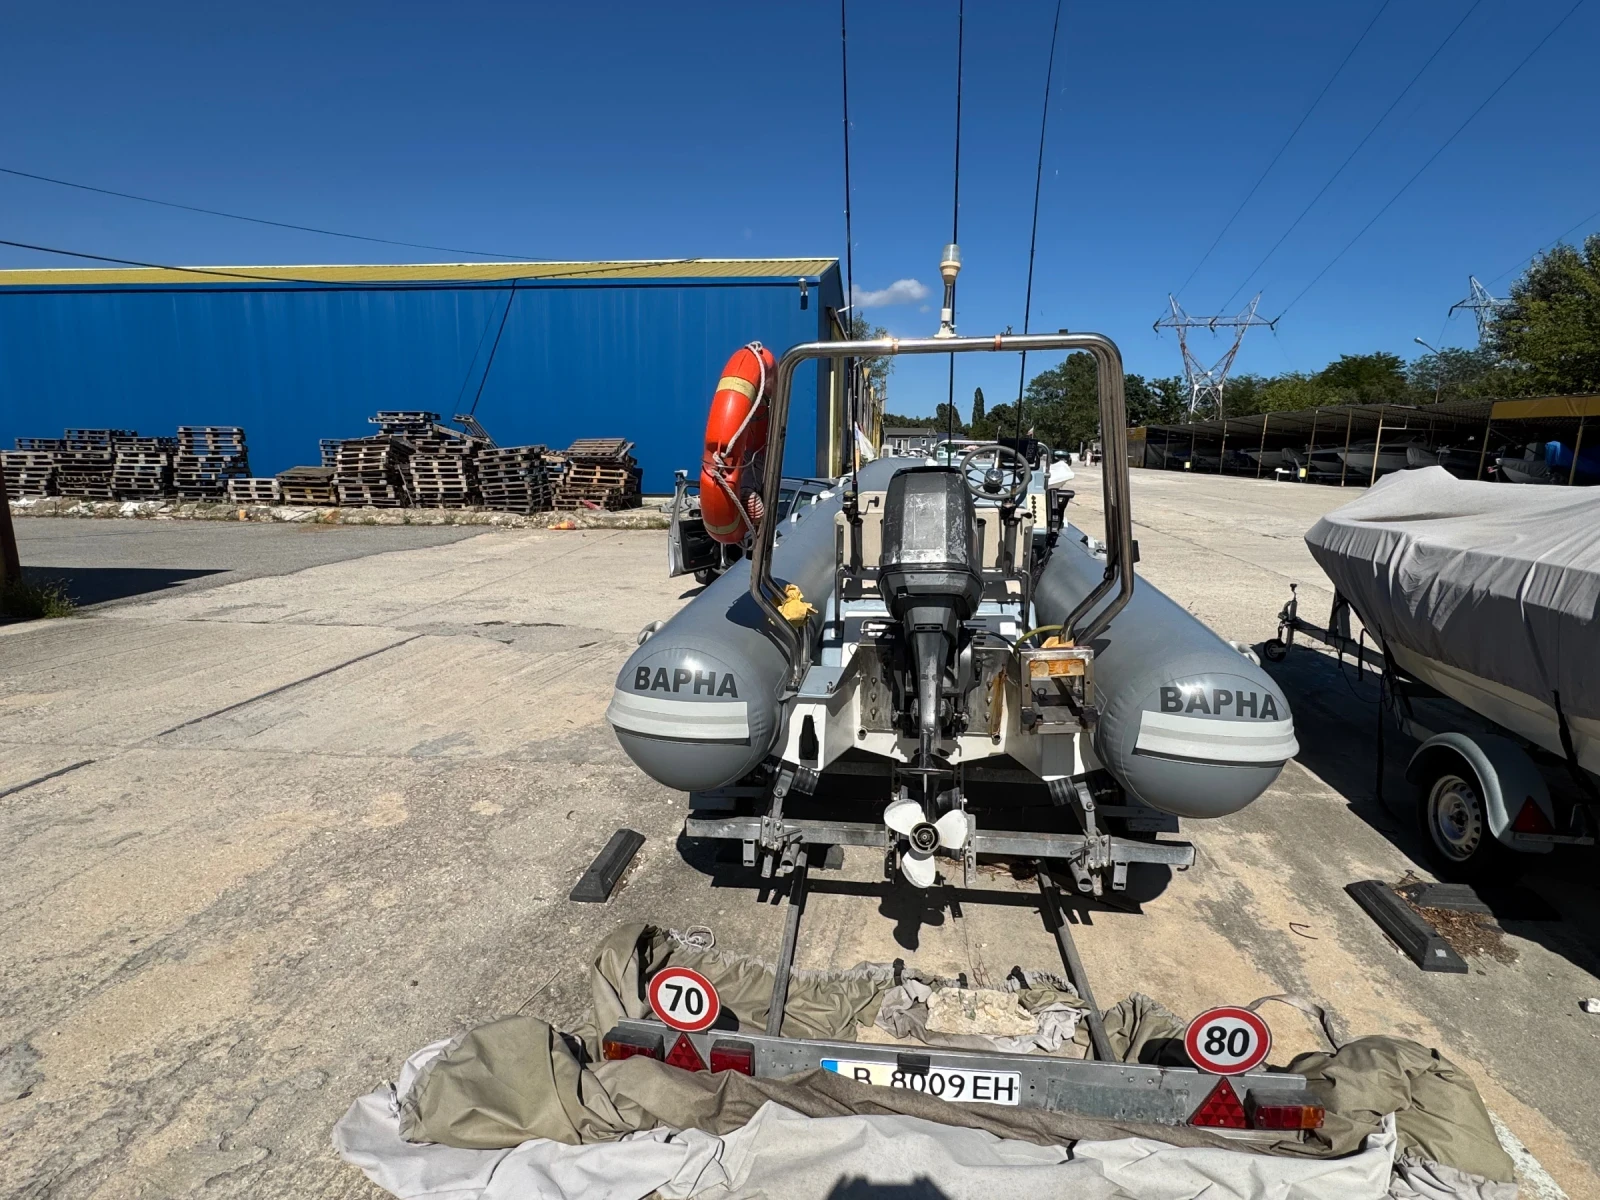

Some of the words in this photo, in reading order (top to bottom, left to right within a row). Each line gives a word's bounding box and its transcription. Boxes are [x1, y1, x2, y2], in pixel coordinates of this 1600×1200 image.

[633, 666, 739, 698] ВАРНА
[1159, 686, 1279, 721] ВАРНА
[665, 983, 704, 1016] 70
[1204, 1025, 1250, 1058] 80
[891, 1070, 966, 1098] 8009
[972, 1075, 1014, 1101] EH
